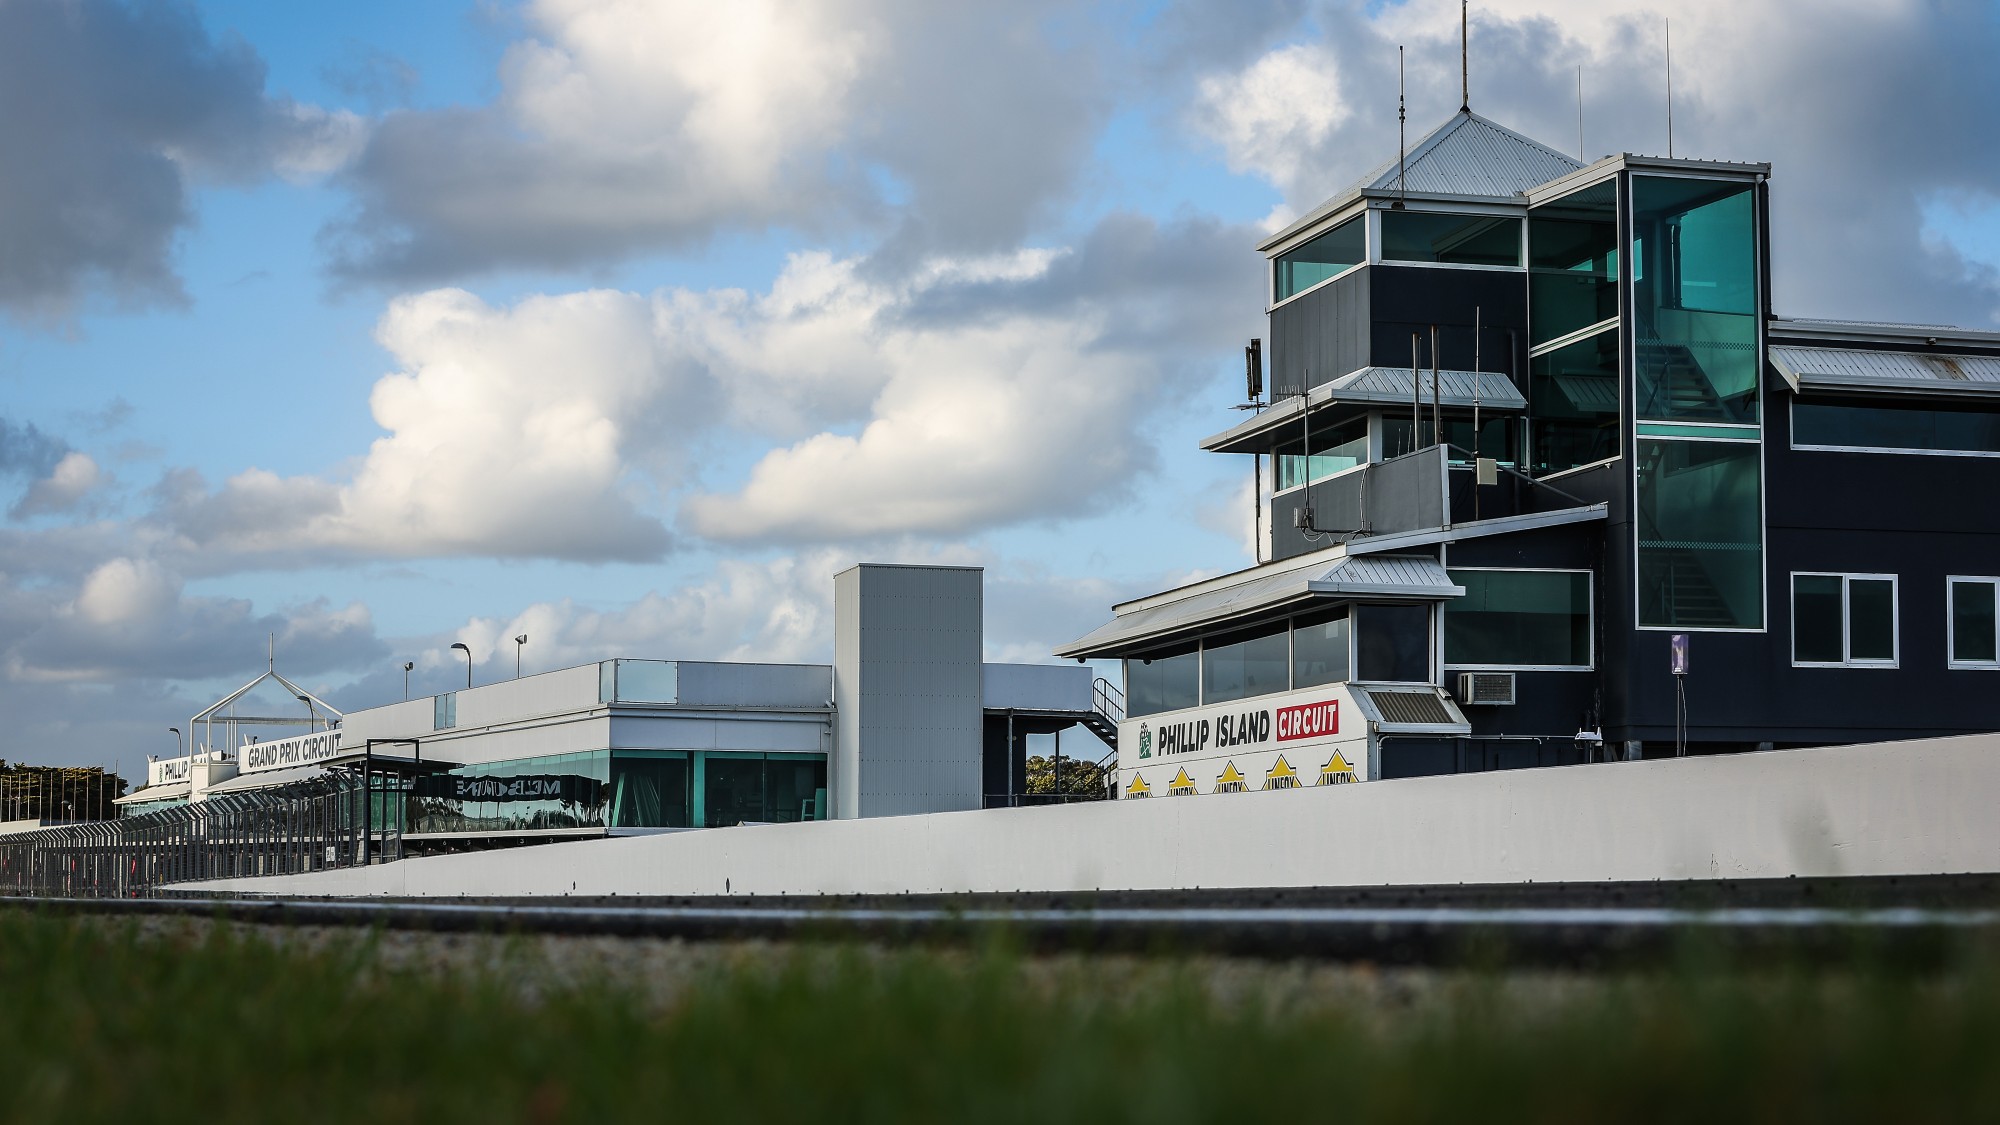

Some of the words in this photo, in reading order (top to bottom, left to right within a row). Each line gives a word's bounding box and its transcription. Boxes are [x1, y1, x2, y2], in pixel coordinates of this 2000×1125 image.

[1158, 719, 1209, 757] PHILLIP
[1215, 709, 1270, 748] ISLAND
[1278, 704, 1337, 738] CIRCUIT
[248, 746, 276, 769] GRAND
[279, 740, 301, 764] PRIX
[302, 733, 342, 761] CIRCUIT
[164, 761, 188, 780] PHILLIP
